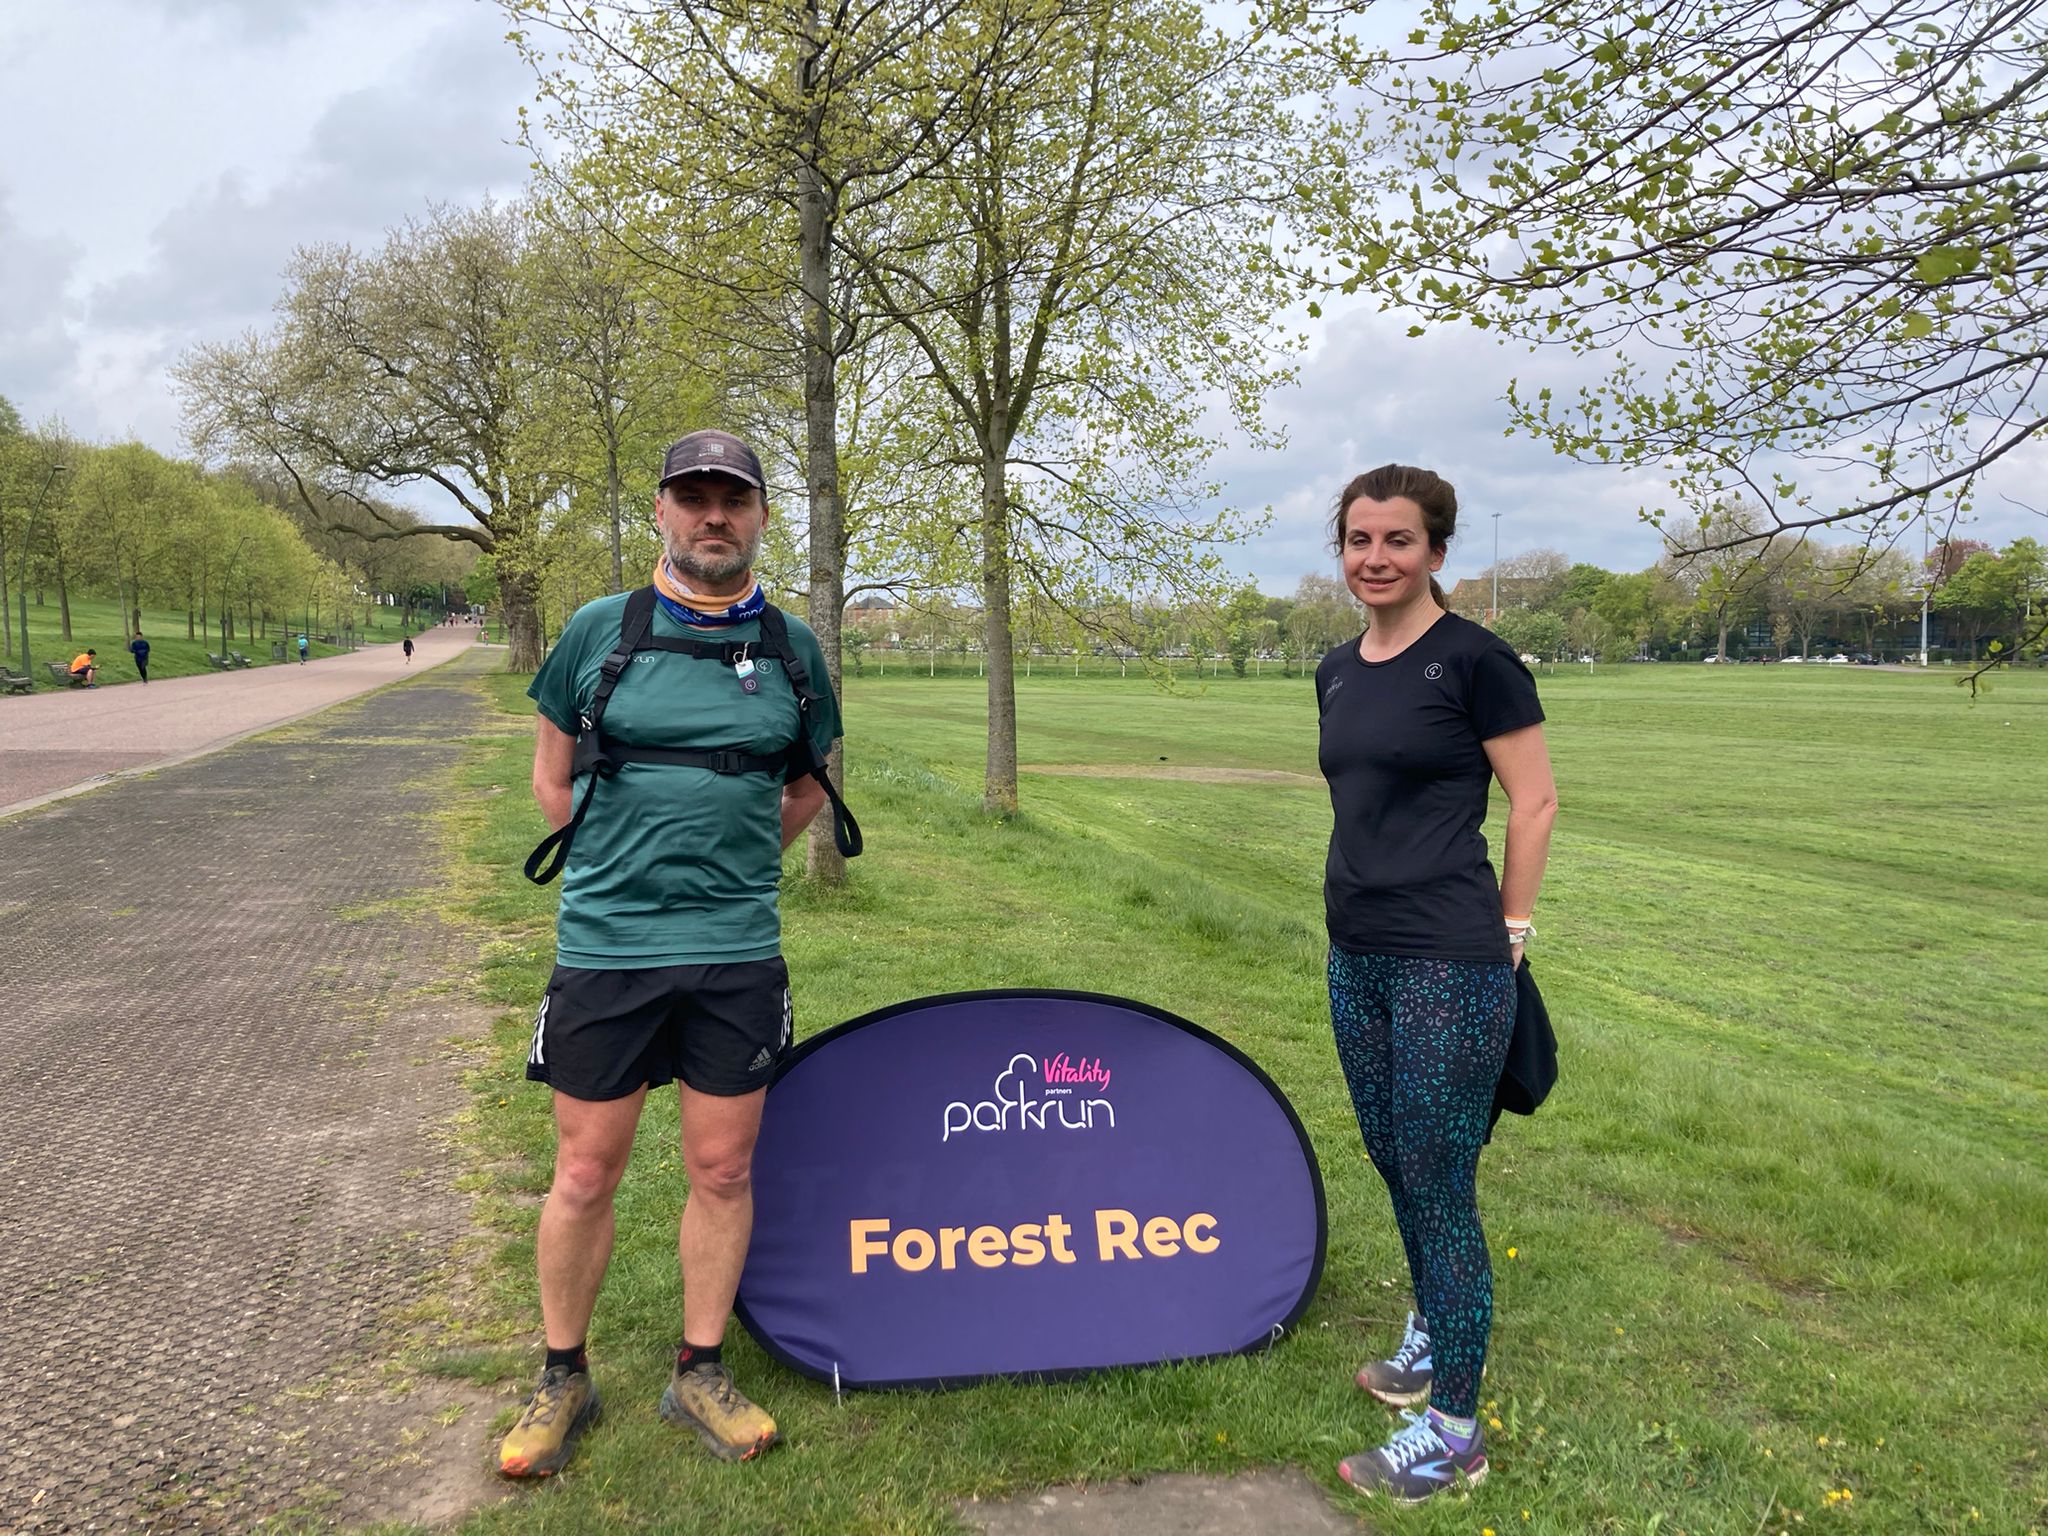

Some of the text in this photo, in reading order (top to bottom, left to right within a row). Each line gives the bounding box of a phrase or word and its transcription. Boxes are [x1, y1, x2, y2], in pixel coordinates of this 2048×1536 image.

[1043, 1052, 1111, 1092] Vitality
[1045, 1087, 1073, 1096] partners
[942, 1080, 1115, 1142] parkrun
[849, 1208, 1221, 1274] Forest Rec
